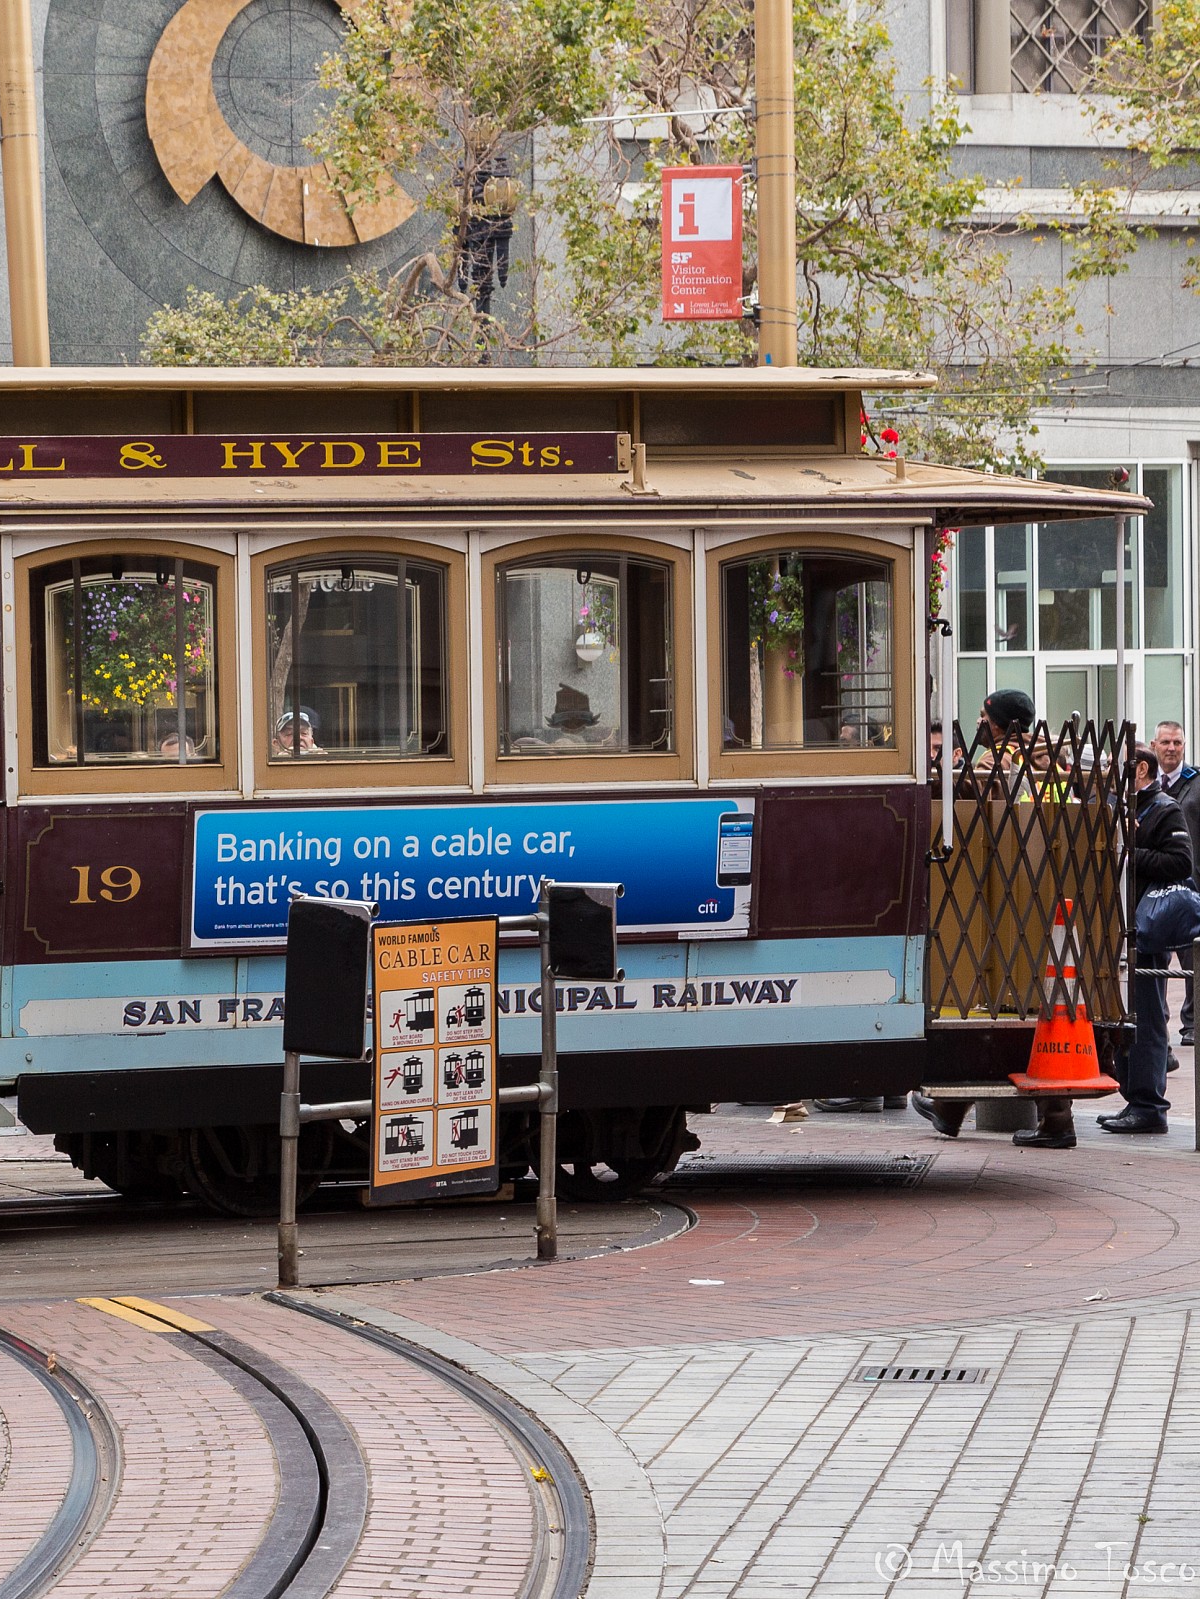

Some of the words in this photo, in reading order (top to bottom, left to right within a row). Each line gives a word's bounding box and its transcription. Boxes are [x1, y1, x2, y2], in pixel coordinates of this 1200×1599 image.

[671, 252, 693, 264] SF
[671, 265, 706, 275] Visitor
[671, 274, 732, 285] Information
[671, 285, 706, 295] Center
[119, 442, 168, 470] &
[220, 441, 421, 470] HYDE
[471, 439, 574, 467] Sts.
[217, 831, 342, 867] Banking
[353, 836, 391, 859] on
[402, 835, 419, 858] a
[431, 826, 512, 858] cable
[522, 831, 575, 858] car,
[70, 865, 142, 904] 19
[214, 874, 303, 906] that's
[315, 879, 349, 900] so
[360, 871, 416, 901] this
[698, 901, 718, 914] citi
[379, 934, 406, 946] WORLD
[408, 932, 440, 944] FAMOUS
[379, 947, 443, 970] CABLE
[447, 943, 491, 964] CAR
[422, 969, 464, 983] SAFETY
[466, 967, 491, 979] TIPS
[497, 985, 638, 1014] NICIPAL
[652, 978, 798, 1010] RAILWAY
[123, 1000, 202, 1027] SAN
[1036, 1042, 1070, 1054] CABLE
[1075, 1043, 1093, 1056] CAR
